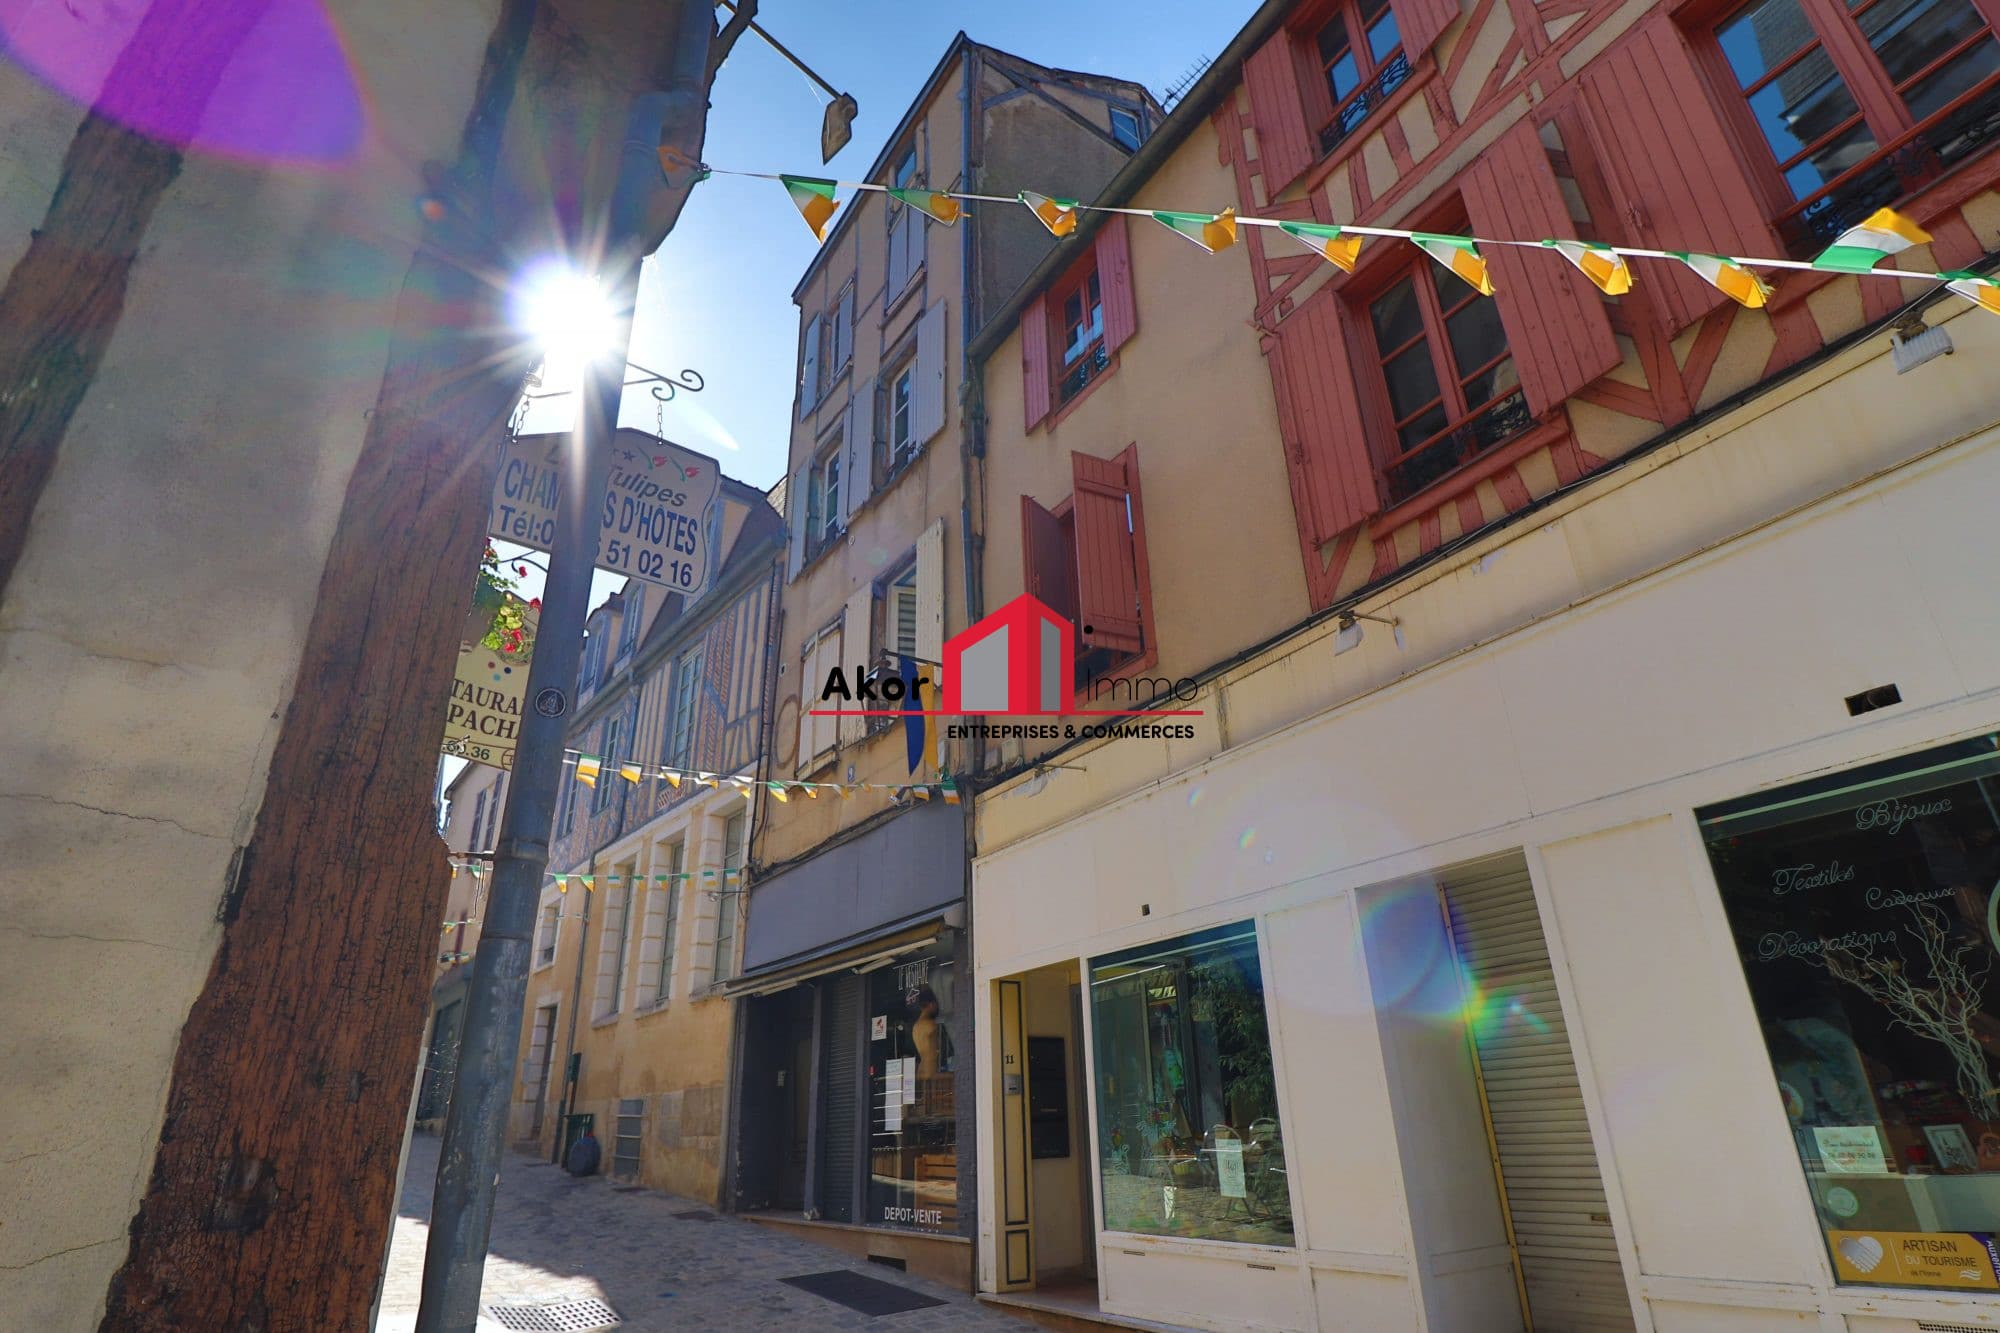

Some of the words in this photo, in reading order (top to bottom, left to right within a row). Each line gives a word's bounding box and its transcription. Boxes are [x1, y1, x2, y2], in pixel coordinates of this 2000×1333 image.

[619, 496, 698, 555] D'HÔTES
[607, 540, 630, 569] 51
[638, 549, 664, 579] 02
[671, 560, 692, 587] 16
[447, 703, 519, 740] PACH
[1856, 797, 1952, 835] Bijoux
[1772, 860, 1855, 895] Textiles
[1866, 887, 1957, 911] Cadeaux
[1759, 930, 1896, 961] Décorations
[1004, 1054, 1015, 1065] 11
[884, 1206, 943, 1225] DEPOT-VENTE
[1903, 1239, 1958, 1253] ARTISAN
[1905, 1255, 1921, 1265] DU
[1922, 1255, 1977, 1268] TOURISME
